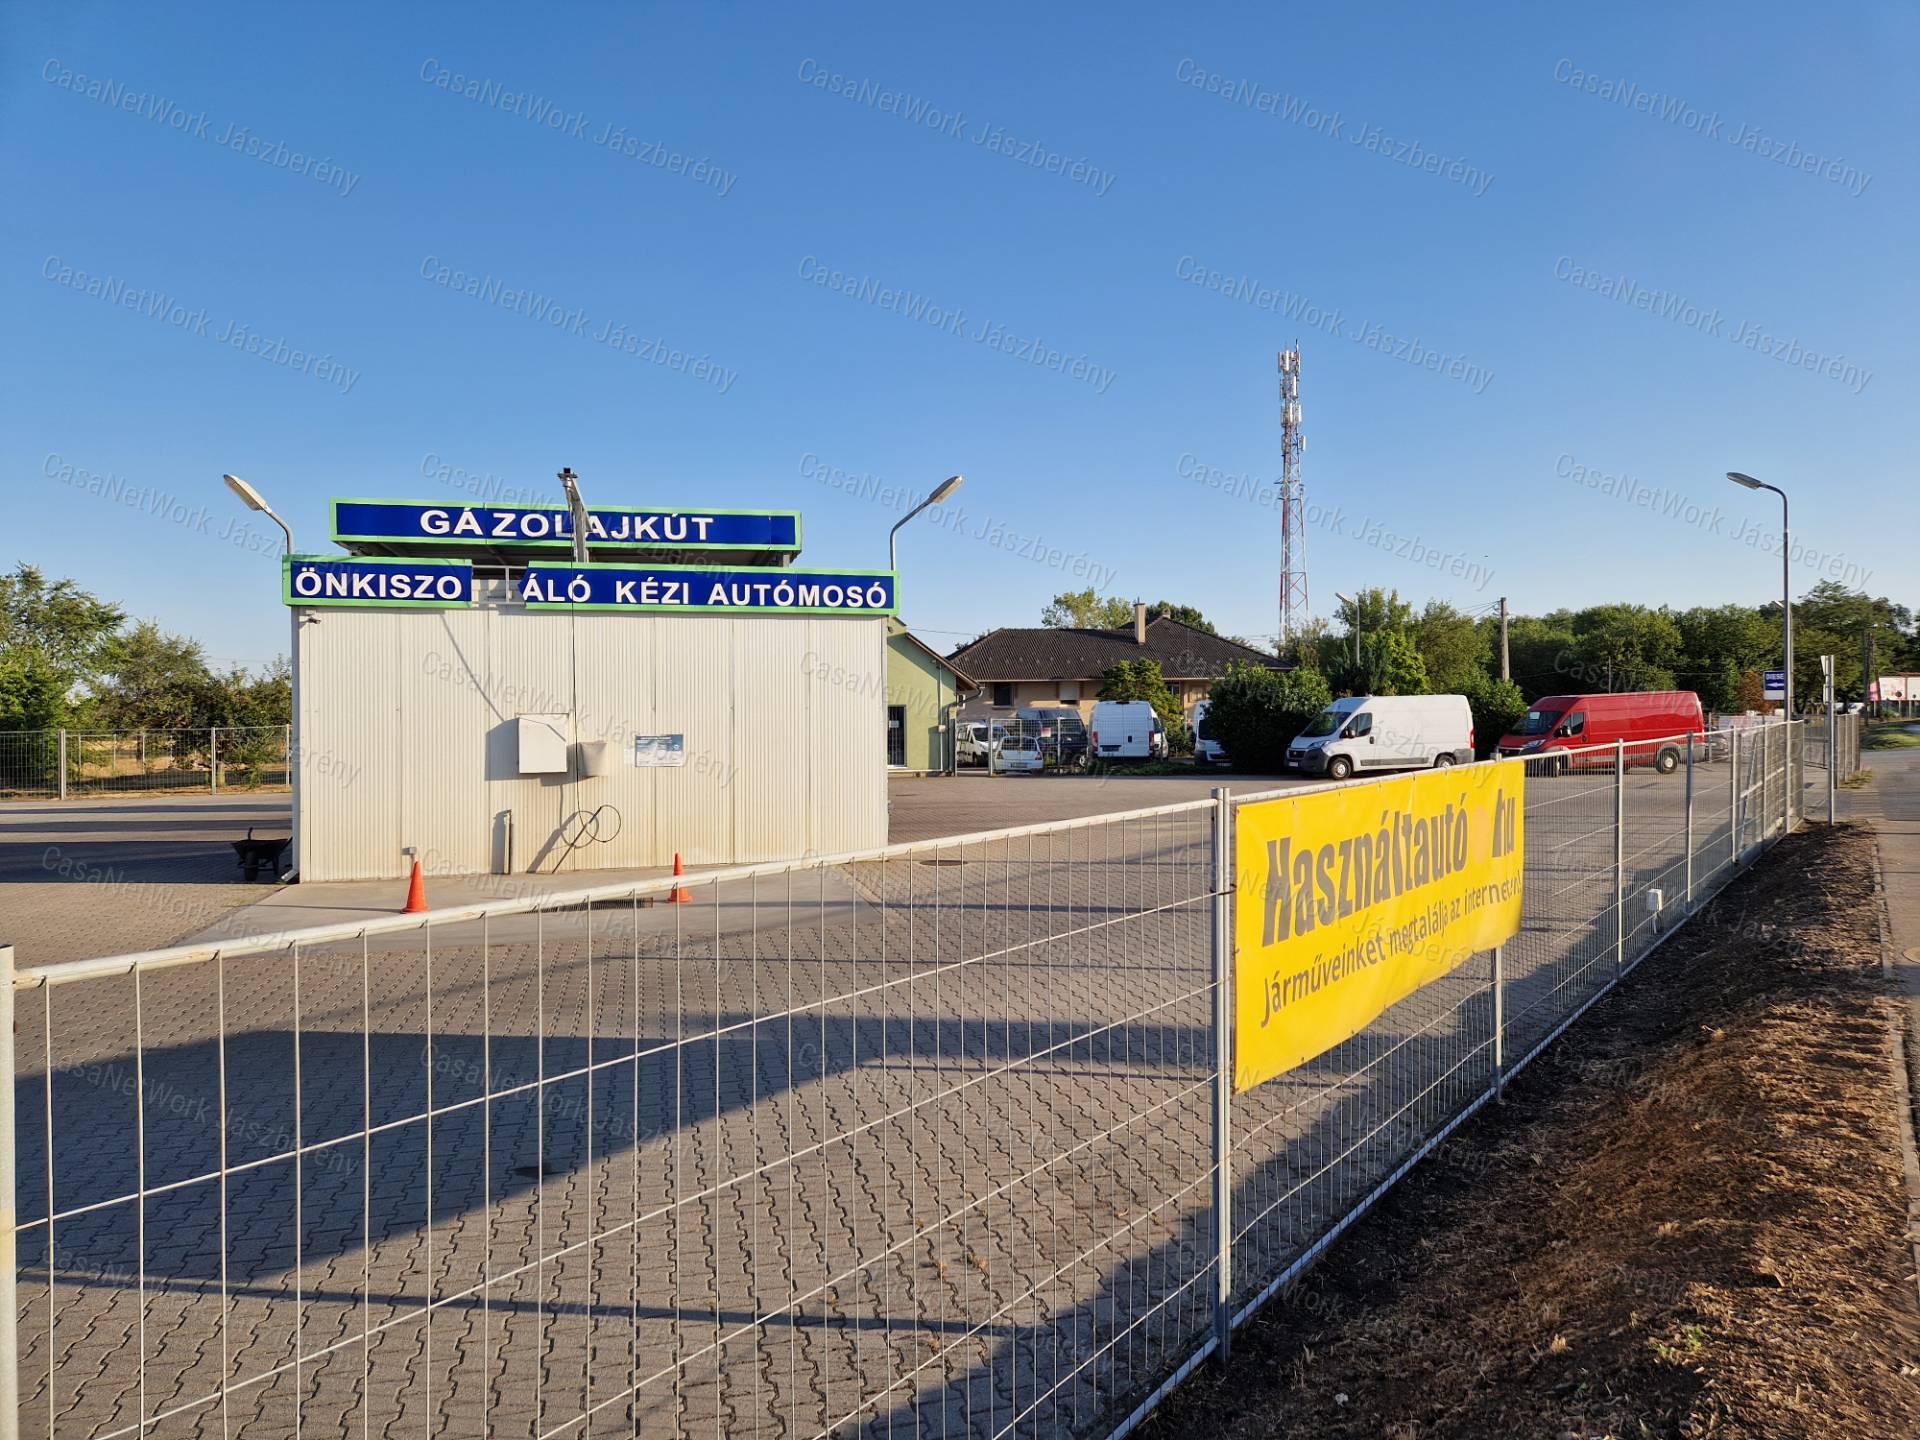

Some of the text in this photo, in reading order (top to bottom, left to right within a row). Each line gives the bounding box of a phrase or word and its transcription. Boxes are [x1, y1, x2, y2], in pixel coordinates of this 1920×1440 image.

[616, 577, 690, 605] KÉZI
[708, 579, 887, 609] AUTÓMOSÓ
[1261, 934, 1386, 1028] Járműveinket
[1390, 904, 1449, 956] megtalálja
[1450, 897, 1461, 920] az
